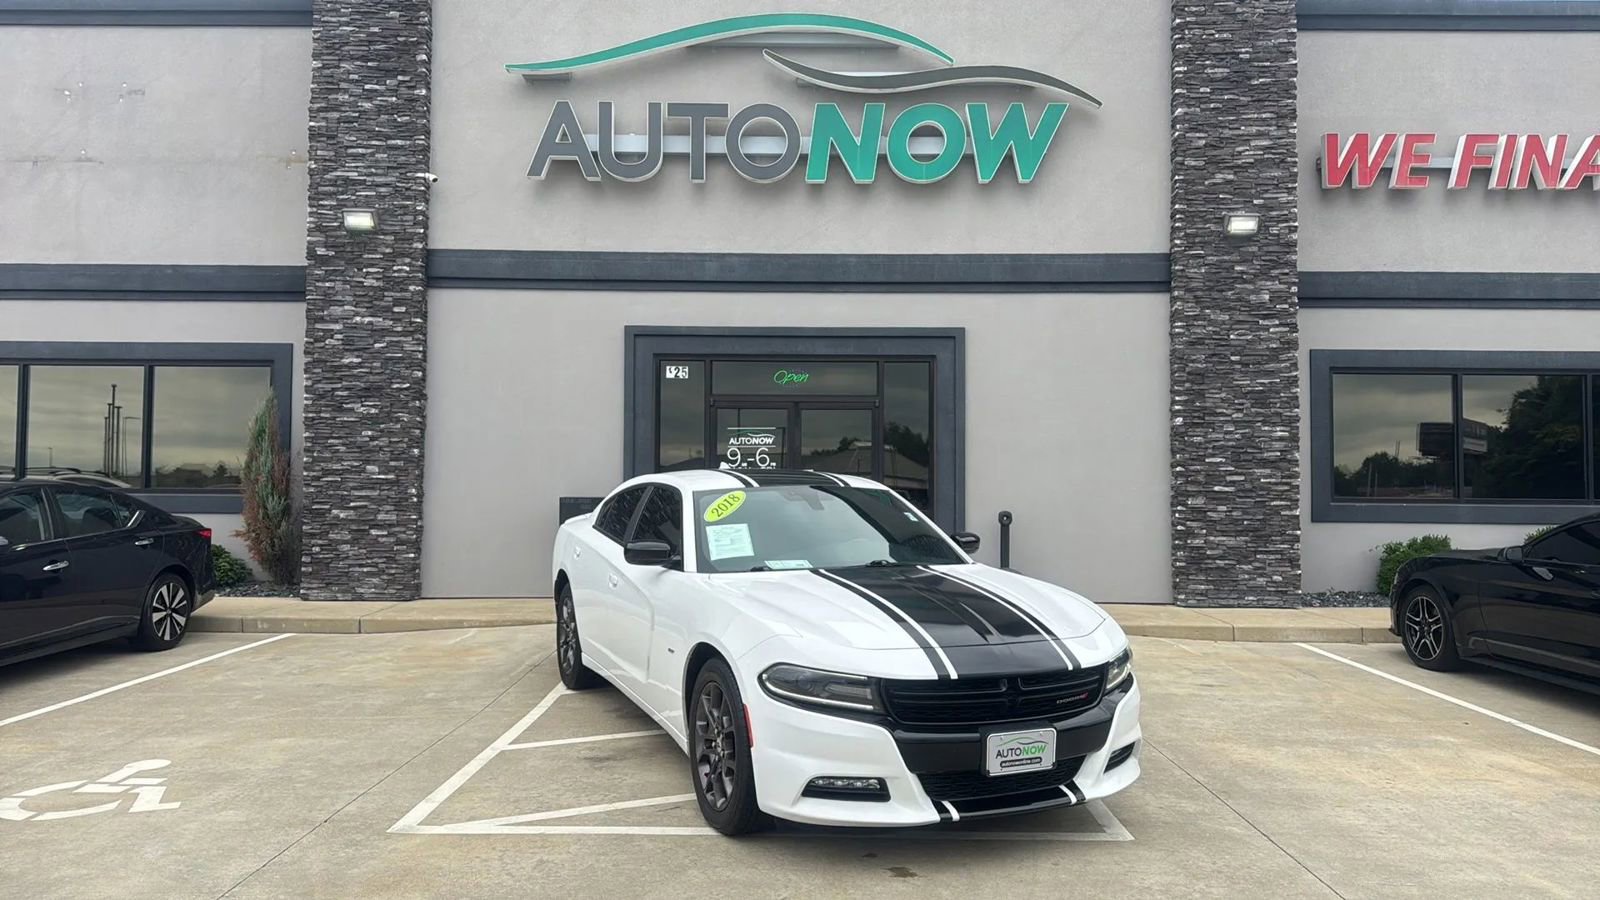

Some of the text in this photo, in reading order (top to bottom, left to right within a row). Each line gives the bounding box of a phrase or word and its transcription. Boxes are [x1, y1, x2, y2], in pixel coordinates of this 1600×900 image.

[526, 100, 1069, 184] AUTONOW
[1321, 132, 1437, 189] WE
[773, 369, 809, 384] Open
[728, 437, 774, 445] AUTONOW
[711, 494, 741, 518] 2018
[995, 744, 1047, 759] AUTONOW
